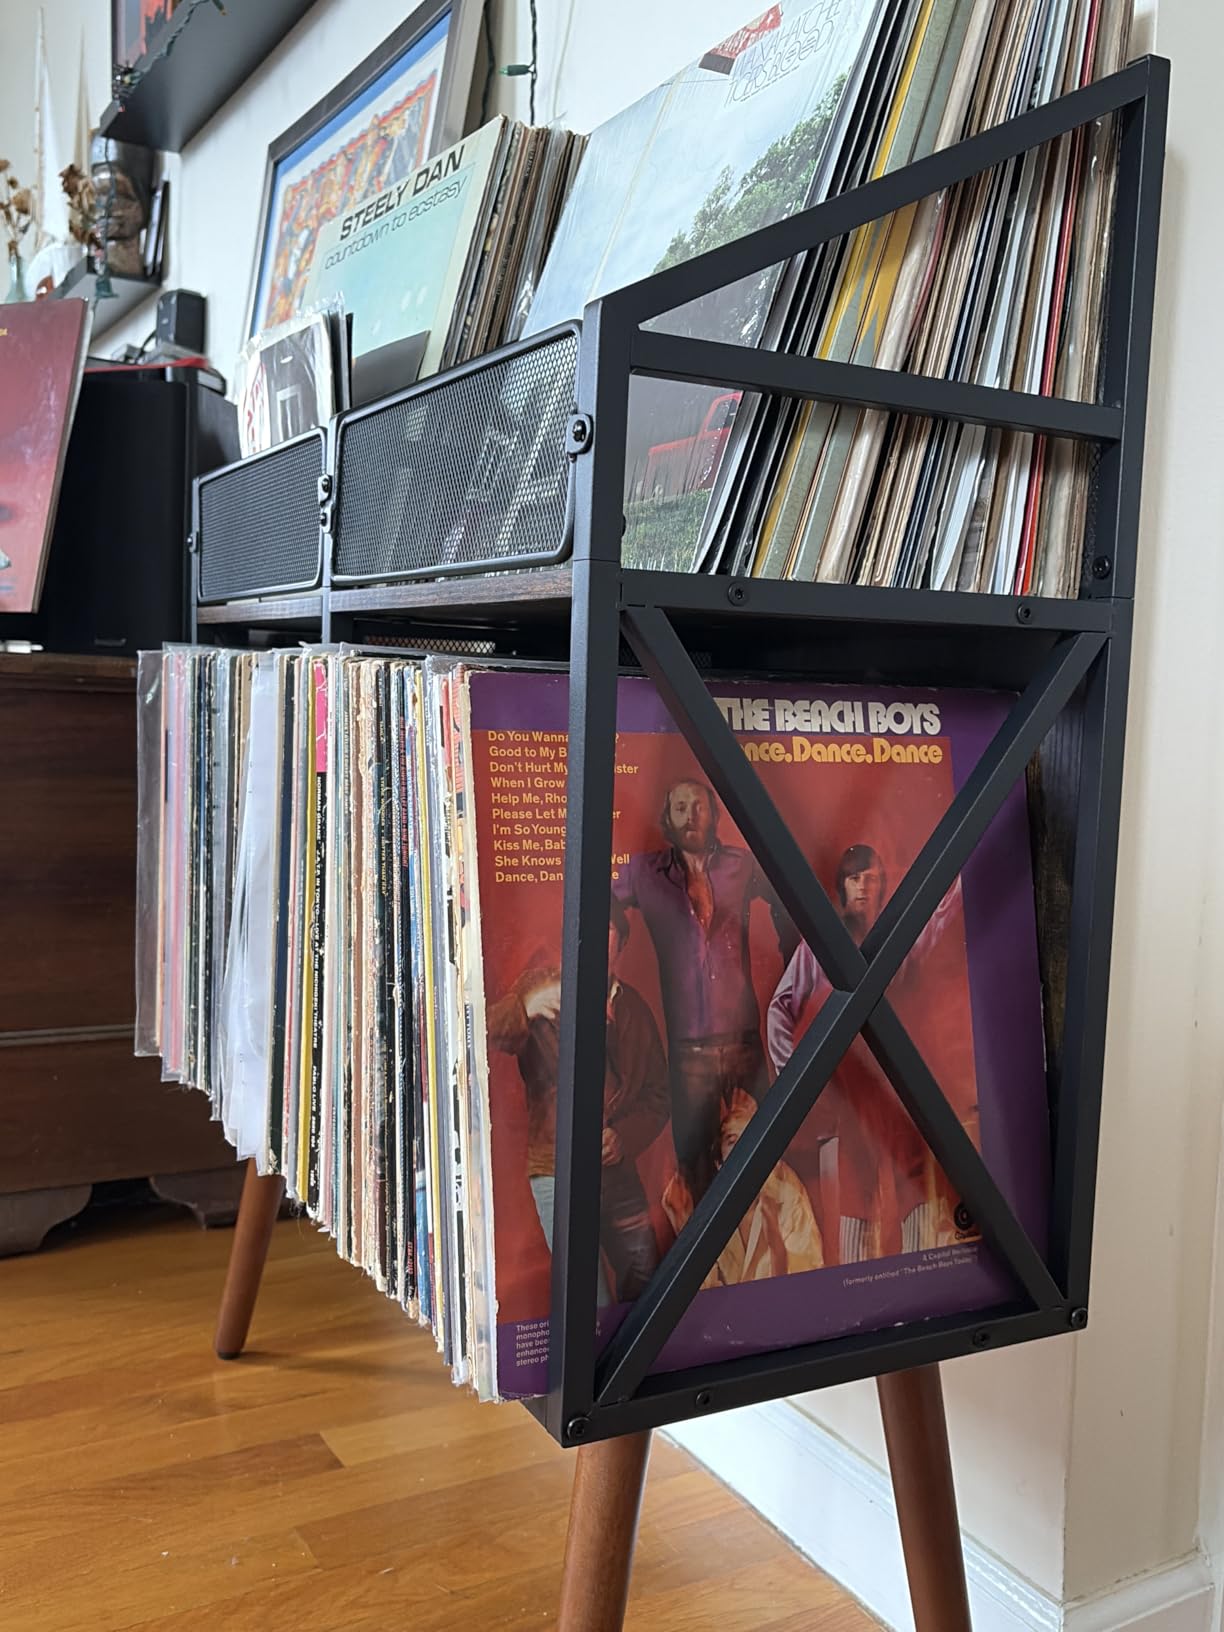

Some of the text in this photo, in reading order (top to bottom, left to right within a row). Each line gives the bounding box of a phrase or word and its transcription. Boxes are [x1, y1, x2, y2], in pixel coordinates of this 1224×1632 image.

[340, 179, 411, 241] STEELY
[412, 144, 466, 197] DAN
[325, 175, 468, 270] countdown to ecstasy
[713, 697, 942, 736] THE BEACH BOYS
[488, 730, 506, 742] Do
[507, 730, 529, 742] You
[489, 746, 522, 757] Good
[524, 747, 537, 757] to
[539, 747, 556, 760] My
[490, 761, 523, 772] Don't
[525, 762, 552, 772] Hurt
[554, 762, 569, 775] My
[490, 777, 566, 788] When I Grow
[491, 793, 568, 806] Help Me, Rho
[492, 808, 533, 819] Please
[535, 808, 556, 819] Let
[492, 824, 567, 837] I'm So Young
[493, 840, 520, 850] Kiss
[522, 840, 544, 851] Me,
[494, 855, 519, 866] She
[521, 855, 562, 866] Knows
[495, 871, 564, 883] Dance, Dan
[516, 1324, 538, 1332] These
[516, 1338, 549, 1350] have bee
[516, 1347, 550, 1358] enhance
[516, 1356, 539, 1367] stereo
